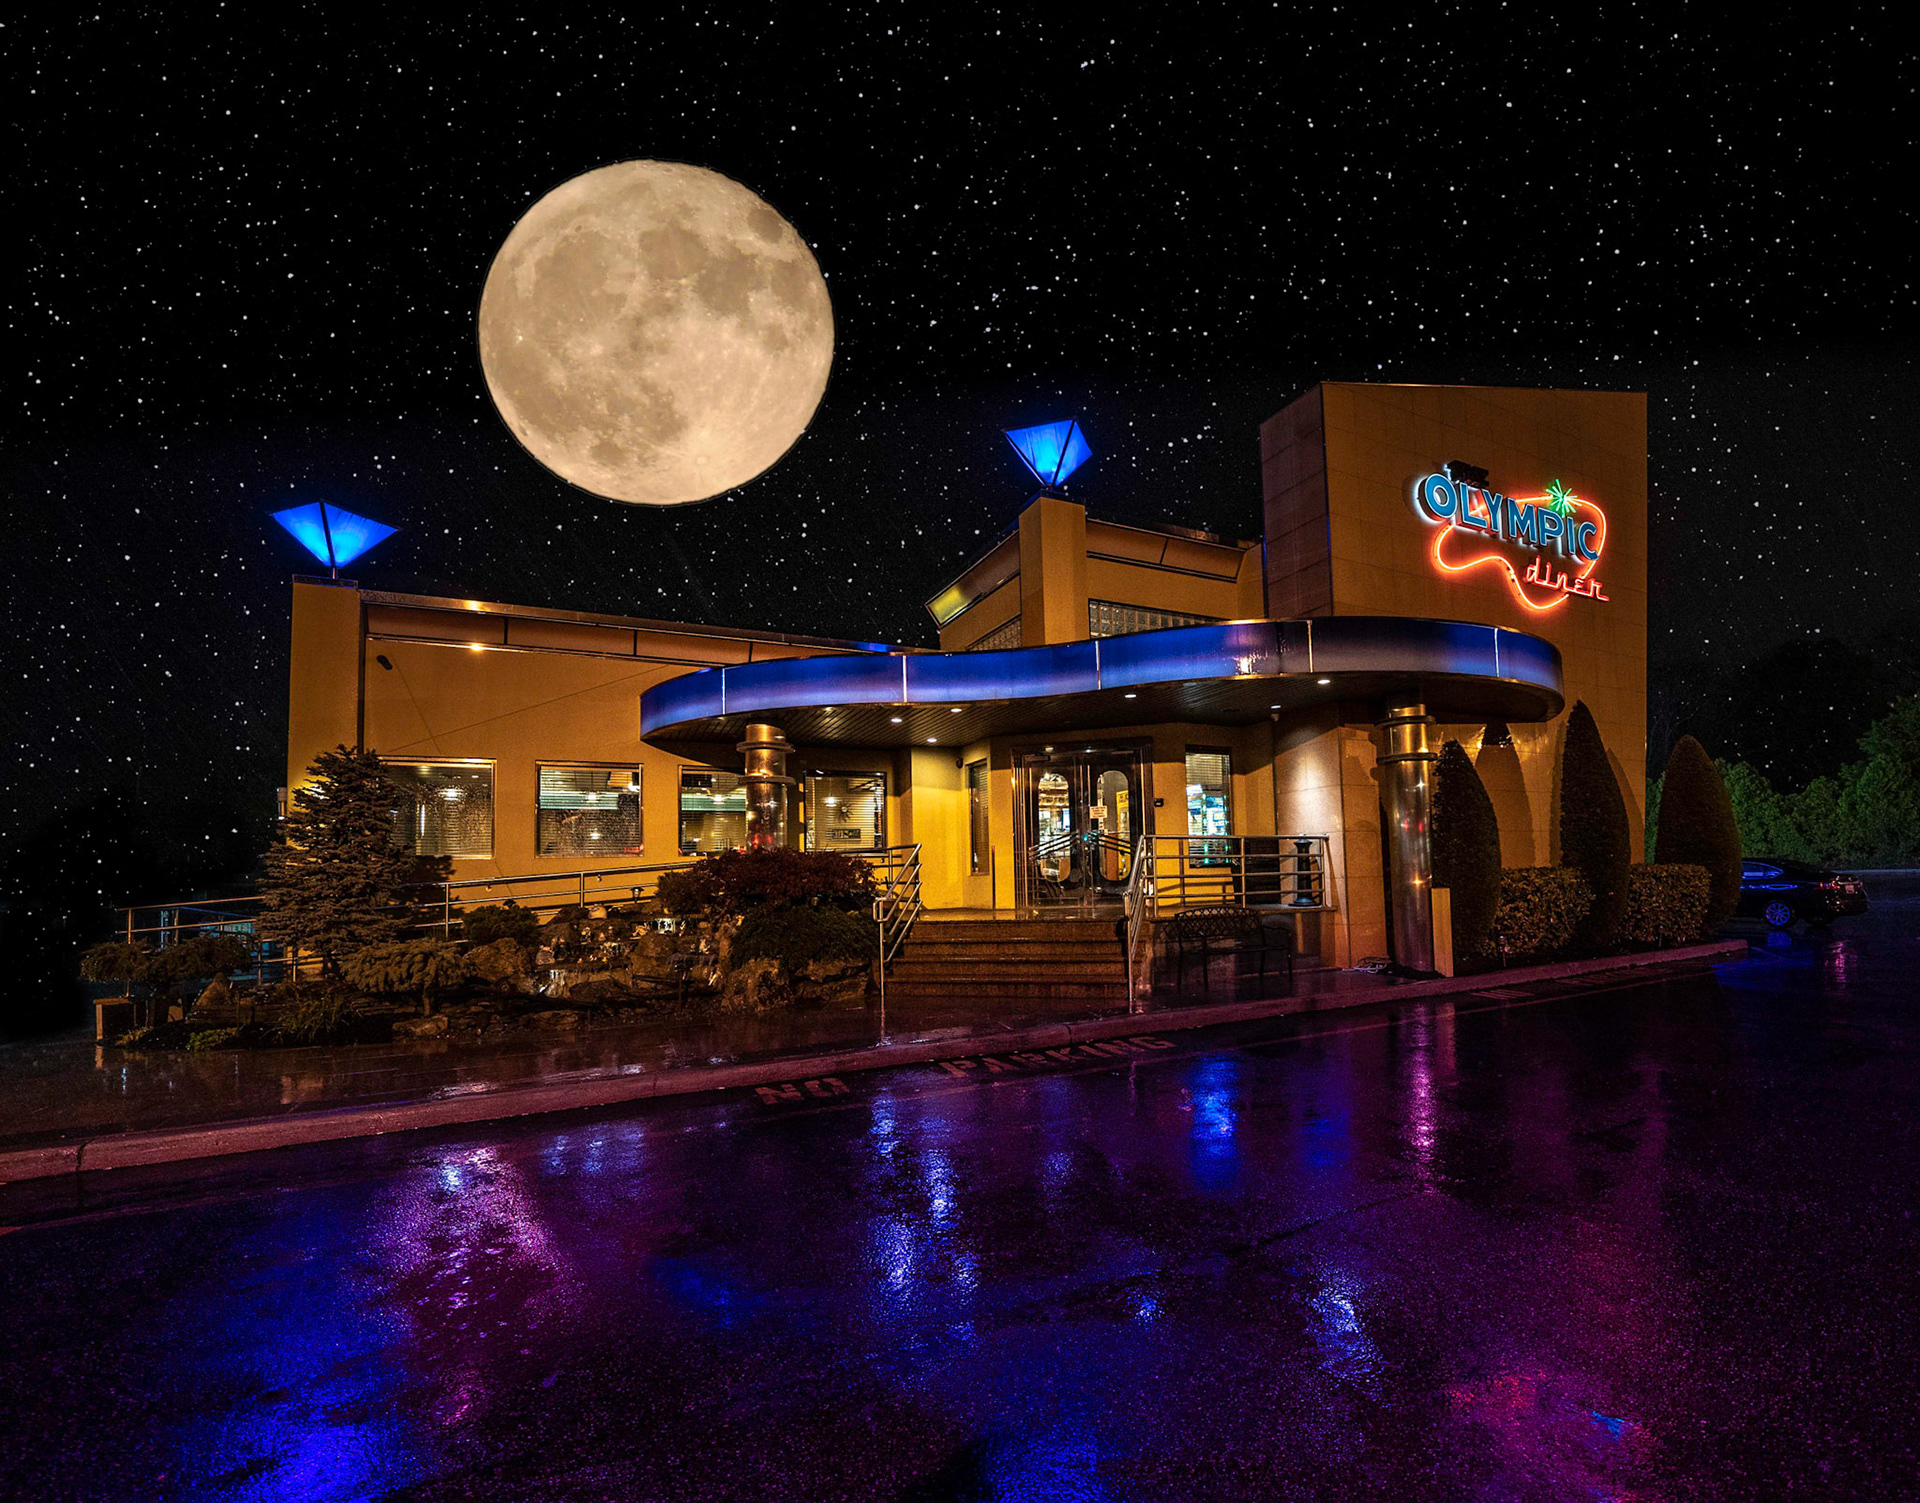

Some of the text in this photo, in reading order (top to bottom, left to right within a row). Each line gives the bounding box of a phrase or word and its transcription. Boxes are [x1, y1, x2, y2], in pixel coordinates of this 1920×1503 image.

[1422, 473, 1600, 562] OLYMPIC
[1525, 555, 1610, 603] diner
[755, 1036, 1178, 1105] NO PARKING
